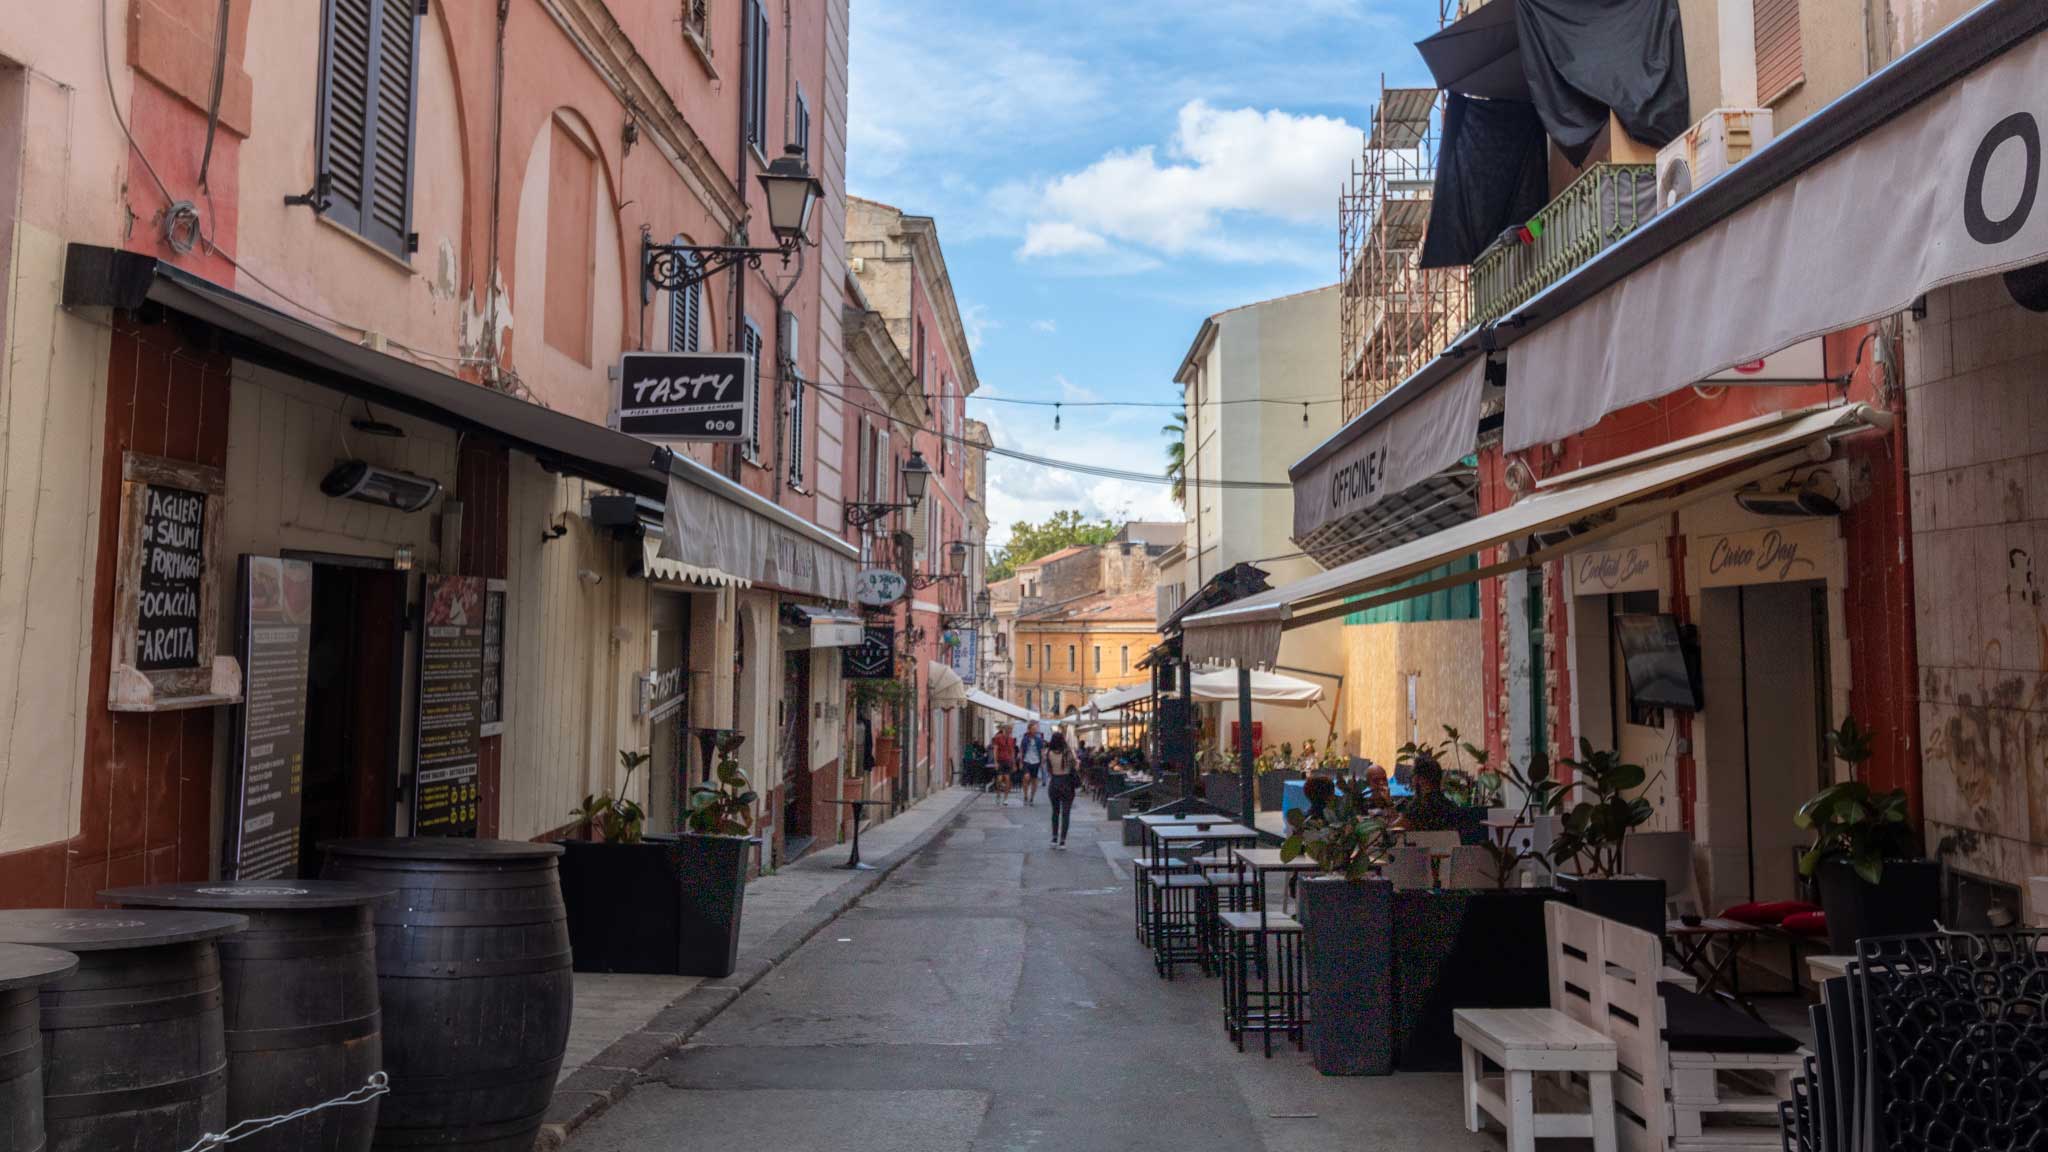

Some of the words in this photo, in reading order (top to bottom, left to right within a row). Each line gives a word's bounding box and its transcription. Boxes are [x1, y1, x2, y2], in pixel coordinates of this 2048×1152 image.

[633, 373, 735, 403] TASTY
[1332, 450, 1377, 509] OFFICINE
[1579, 552, 1622, 590] Cocktail
[1620, 548, 1650, 583] Bar
[1709, 536, 1755, 574] Civico
[1756, 528, 1815, 581] Day
[136, 625, 195, 662] FARCITA
